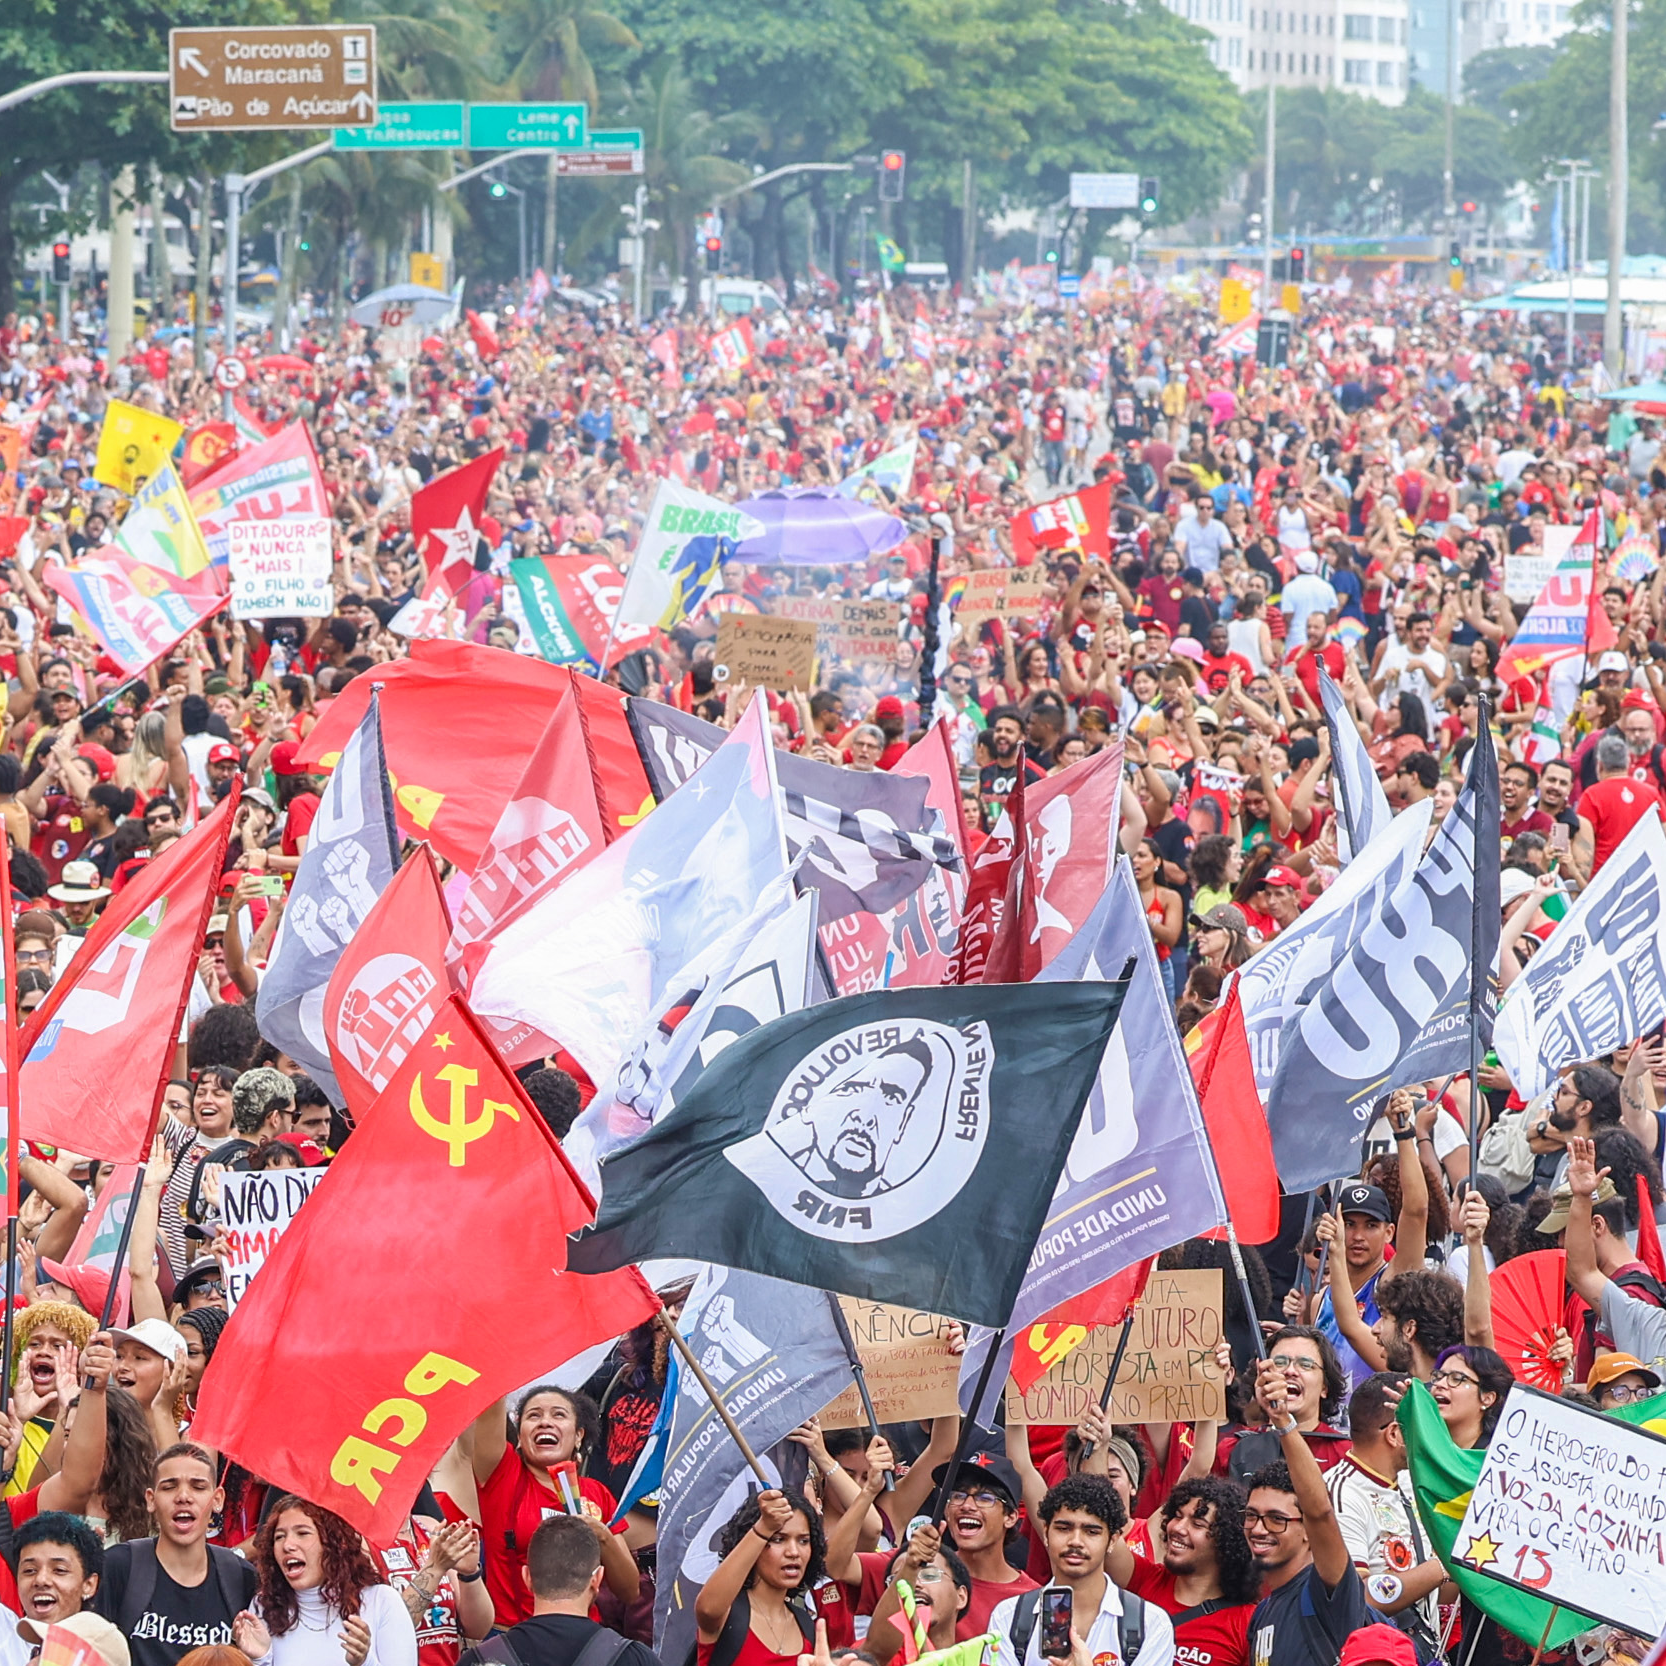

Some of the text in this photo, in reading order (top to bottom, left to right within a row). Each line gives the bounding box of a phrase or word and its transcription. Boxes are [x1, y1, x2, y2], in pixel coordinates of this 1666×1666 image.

[224, 40, 331, 60] Corcovado
[225, 64, 323, 85] Maracanã
[197, 95, 349, 121] Pão de Açúcar
[518, 113, 560, 124] Leme
[506, 128, 560, 142] Centro
[233, 523, 317, 540] DITADURA
[452, 530, 473, 555] PT
[249, 540, 305, 557] NUNCA
[244, 579, 304, 593] O FILHO
[235, 594, 284, 609] TAMBÉM
[223, 1171, 279, 1227] NÃO
[1163, 1348, 1219, 1381] EM PÉ
[1111, 1390, 1141, 1419] NO
[1148, 1382, 1219, 1420] PRATO
[1489, 1443, 1524, 1469] SE
[1505, 1408, 1528, 1440] O
[1530, 1418, 1619, 1477] HERDEIRO
[1618, 1454, 1651, 1484] DO
[1472, 1497, 1521, 1537] VIRA
[1527, 1516, 1543, 1540] O
[1477, 1466, 1666, 1568] A VOZ DA COZINHA
[1512, 1543, 1554, 1591] 13
[131, 1611, 234, 1647] Blessed
